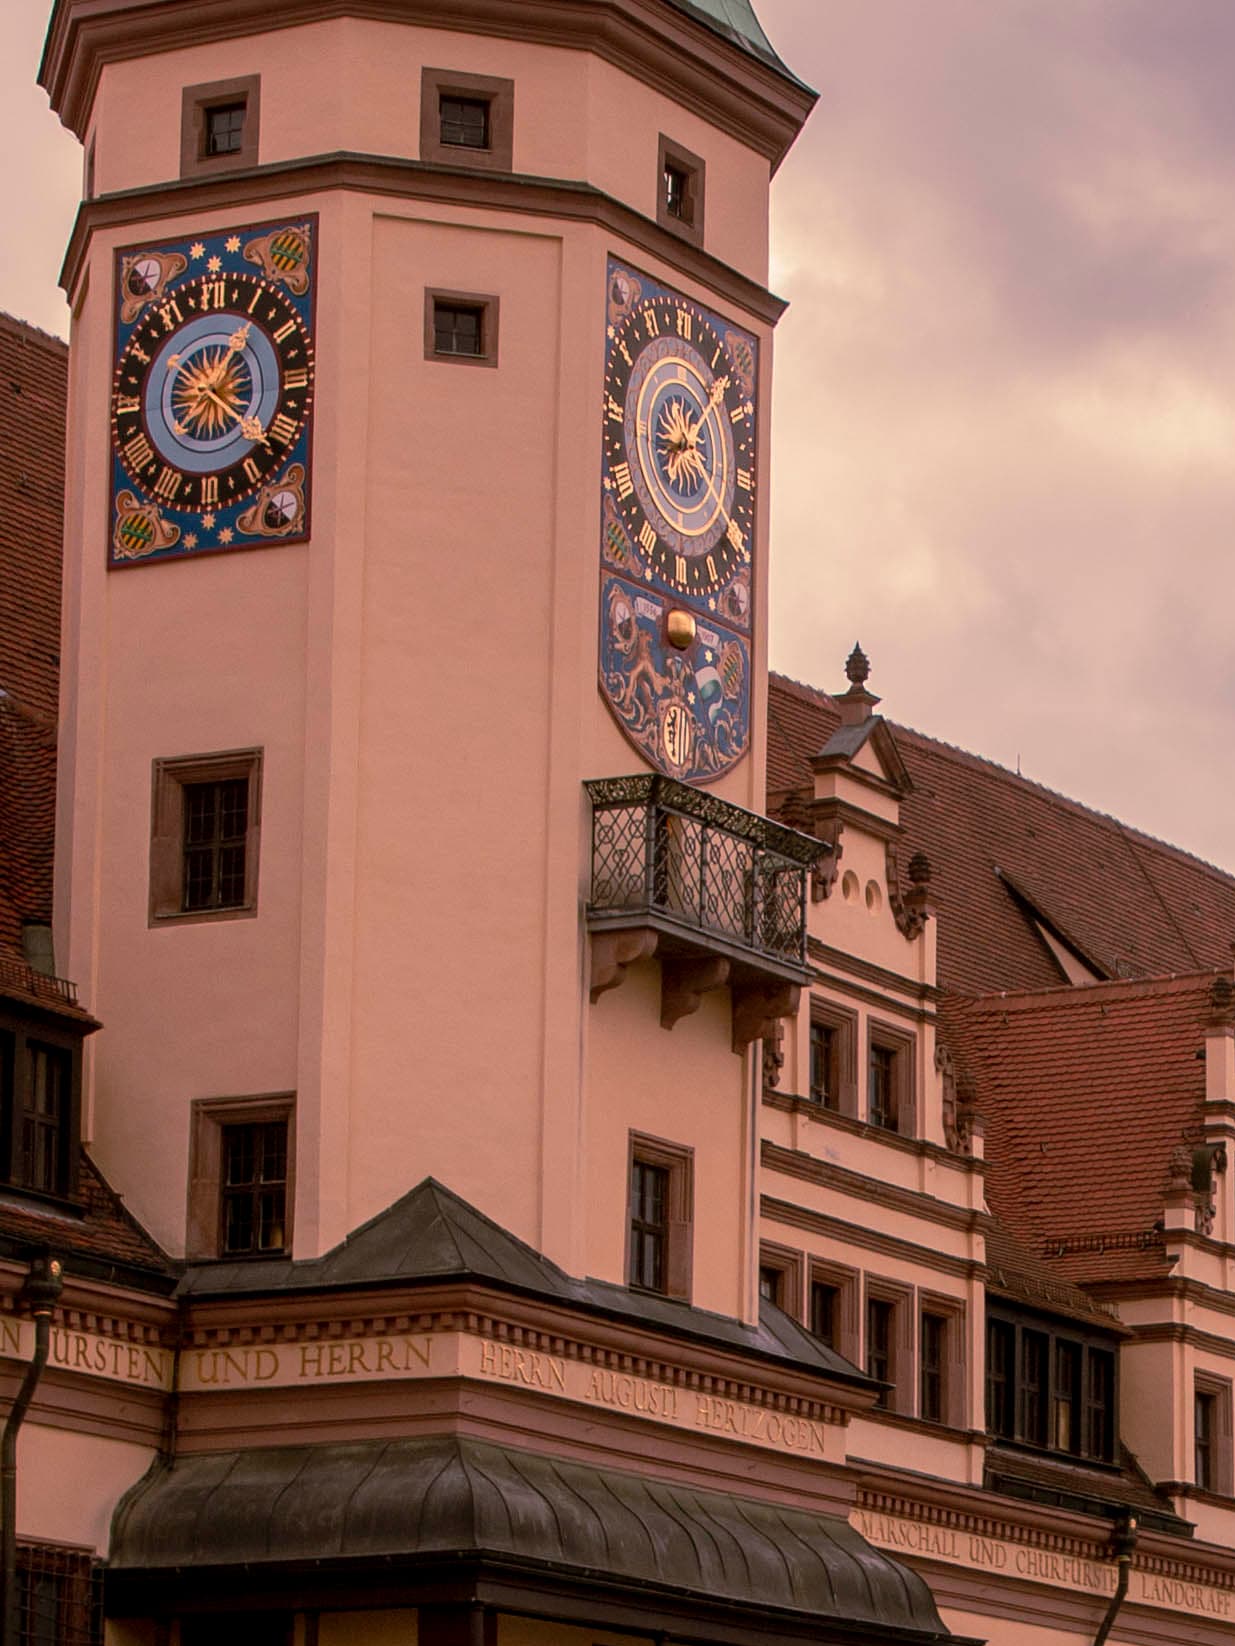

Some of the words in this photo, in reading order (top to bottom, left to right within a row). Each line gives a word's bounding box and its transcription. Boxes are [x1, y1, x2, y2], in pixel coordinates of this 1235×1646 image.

[52, 1328, 164, 1383] ÜRSTEN
[195, 1349, 280, 1384] UND
[299, 1337, 434, 1378] HERRN
[480, 1341, 566, 1392] HERRN
[584, 1370, 679, 1419] AUGUSTI
[695, 1394, 826, 1453] HERTZOGEN
[853, 1510, 960, 1559] MARSCHALL
[969, 1537, 1007, 1569] UND
[1141, 1574, 1232, 1616] LANDGRAFF
